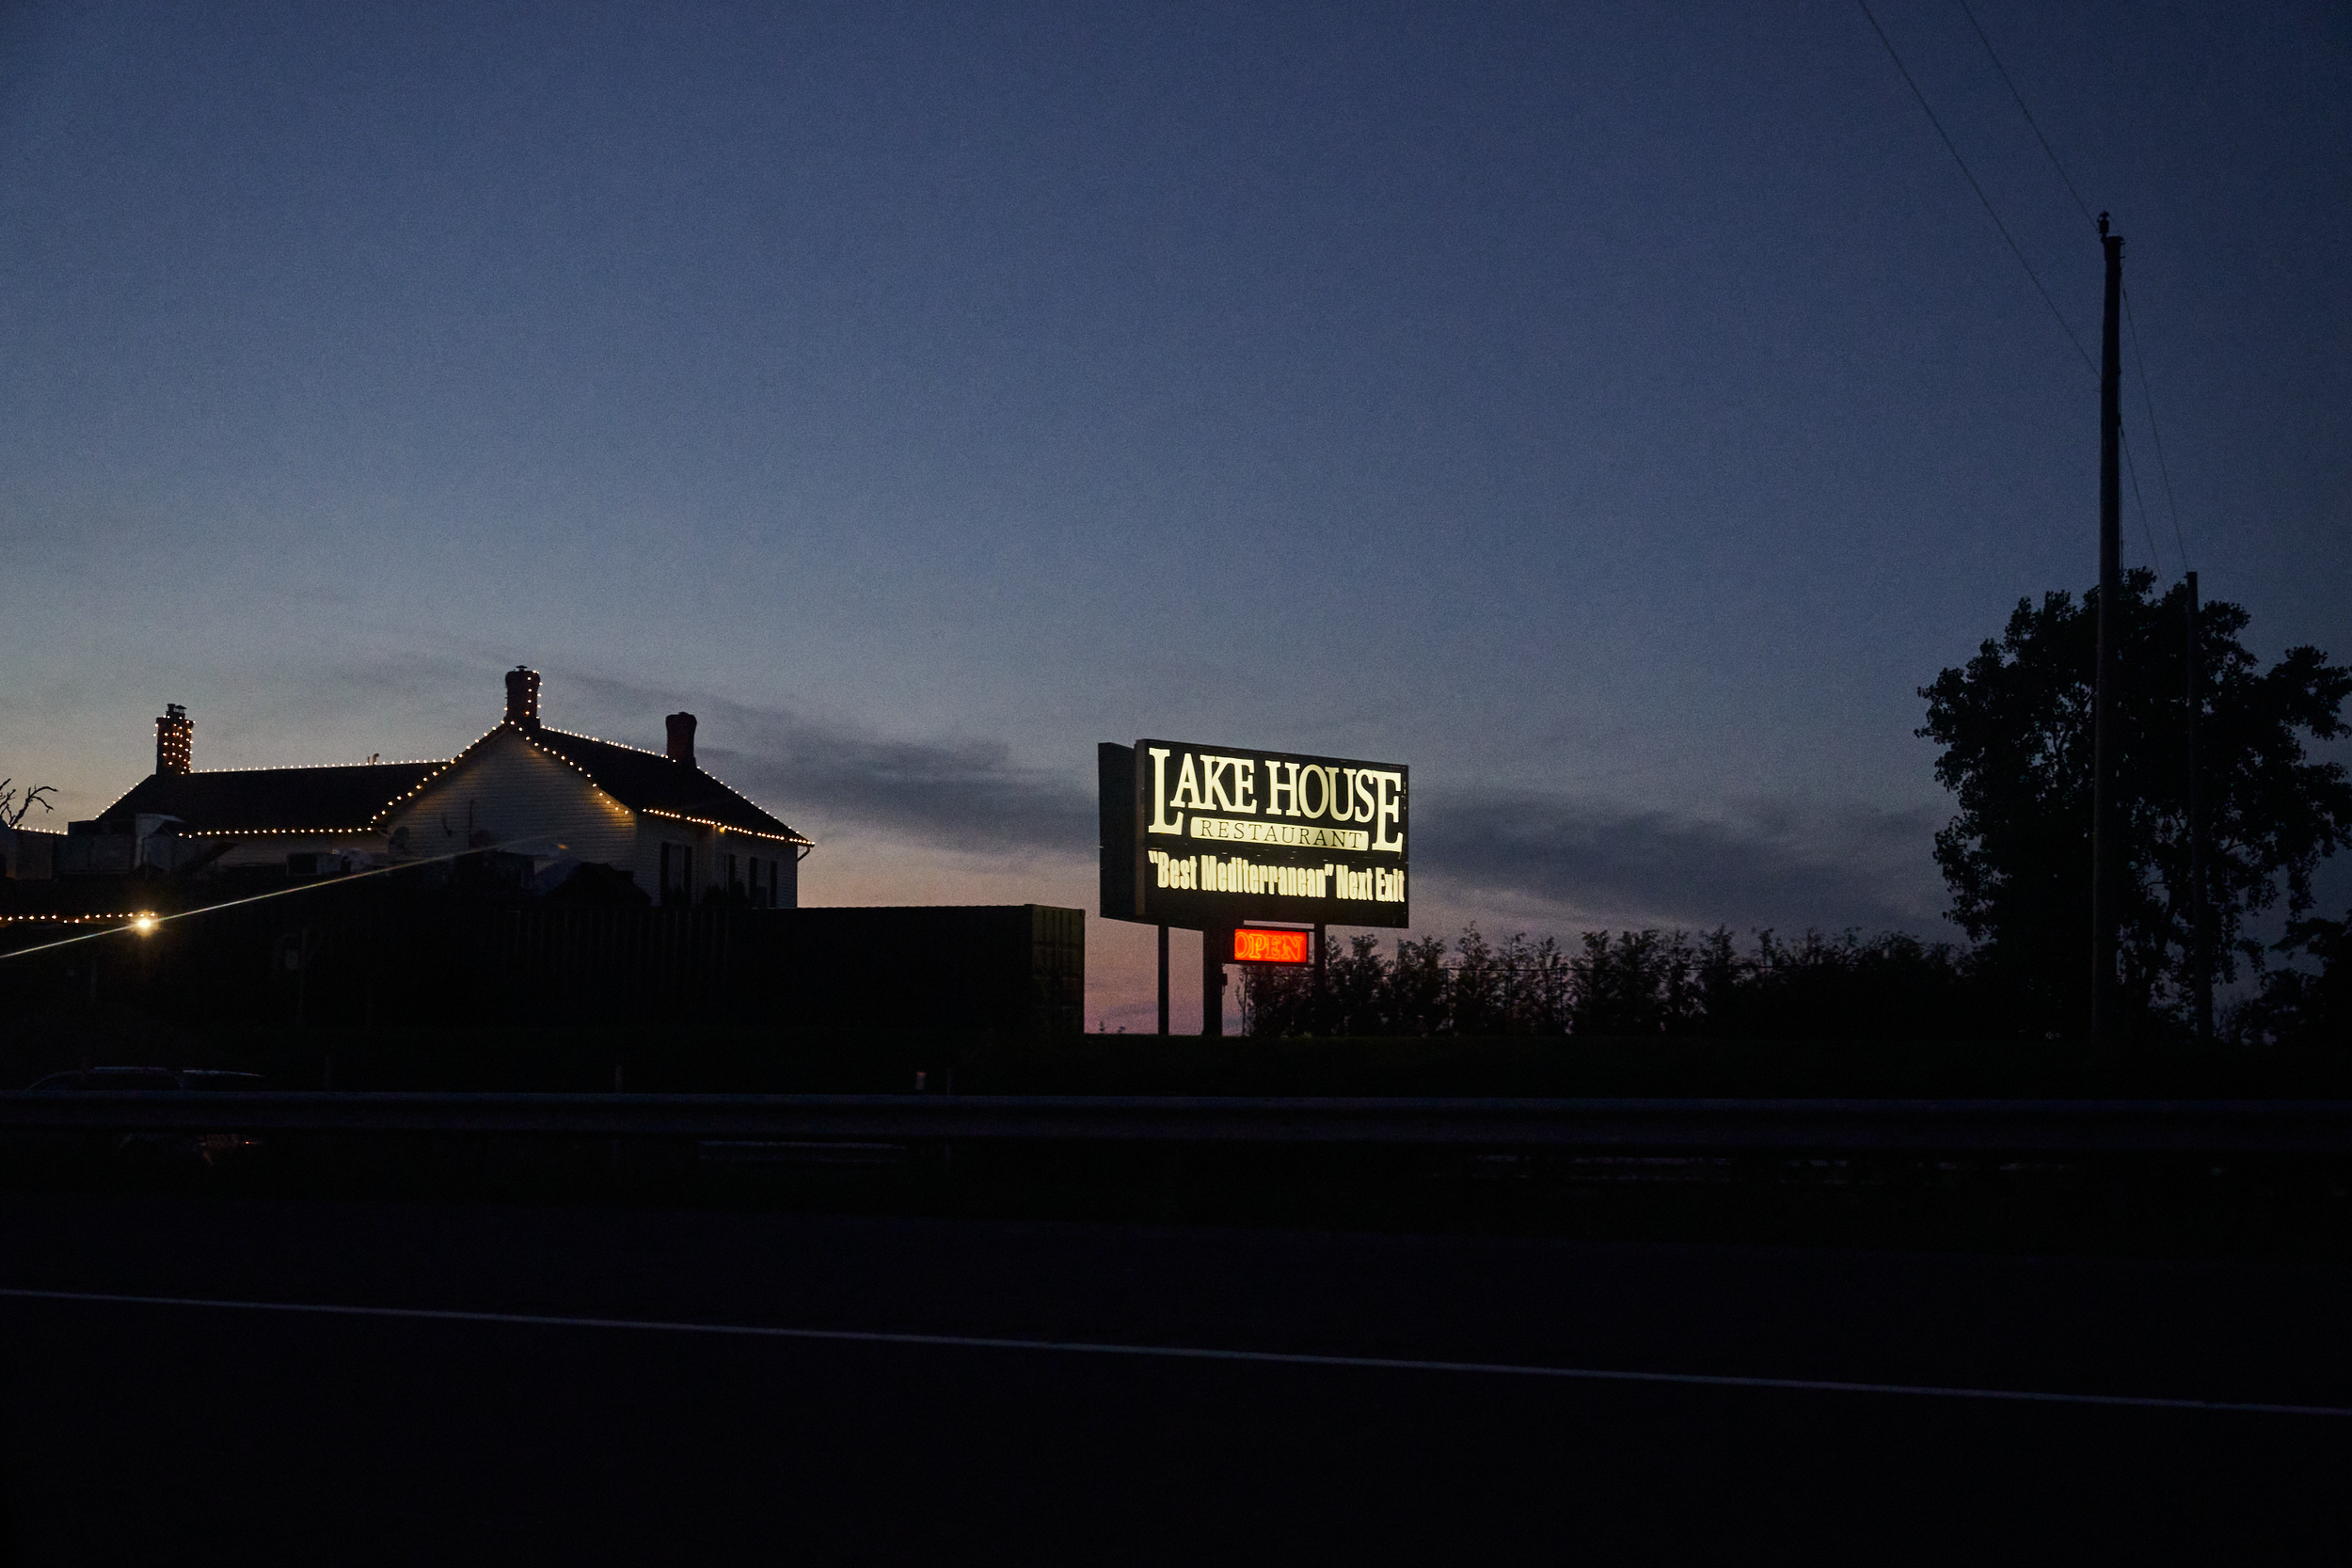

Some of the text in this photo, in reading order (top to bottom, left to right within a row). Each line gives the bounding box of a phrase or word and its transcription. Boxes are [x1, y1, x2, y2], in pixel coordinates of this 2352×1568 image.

[1148, 747, 1404, 853] LAKE HOUSE
[1200, 819, 1363, 849] RESTAURANT
[1148, 850, 1406, 903] "Best Mediterranean" Next Exit
[1234, 931, 1304, 961] OPEN
